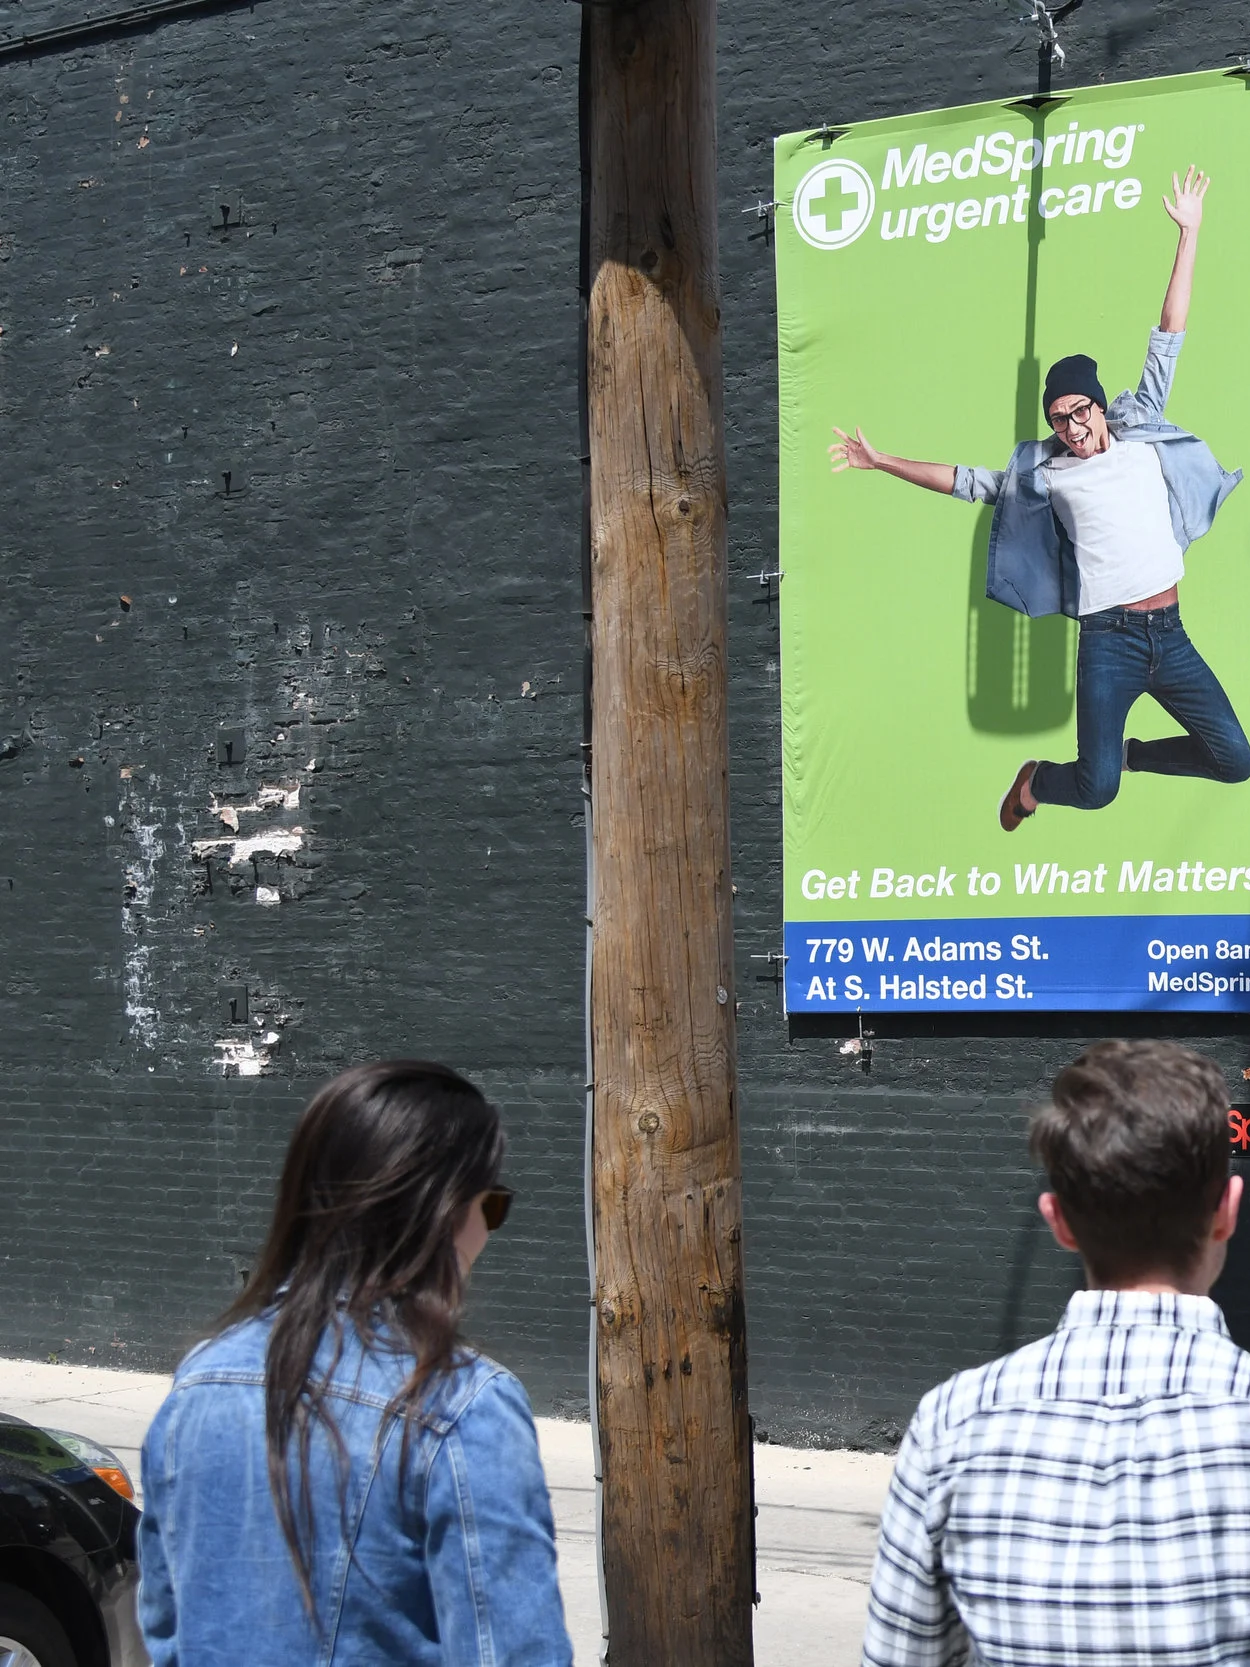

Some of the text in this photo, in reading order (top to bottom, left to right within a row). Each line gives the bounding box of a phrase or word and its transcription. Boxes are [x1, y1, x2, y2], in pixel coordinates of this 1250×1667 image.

[879, 178, 1143, 244] urgent care
[800, 868, 861, 901] Get
[869, 865, 957, 899] Back
[966, 866, 1002, 897] to
[1013, 862, 1109, 895] What
[806, 935, 1049, 963] 779 W. Adams St.
[1147, 939, 1209, 965] Open
[805, 974, 1034, 1001] At S. Halsted St.
